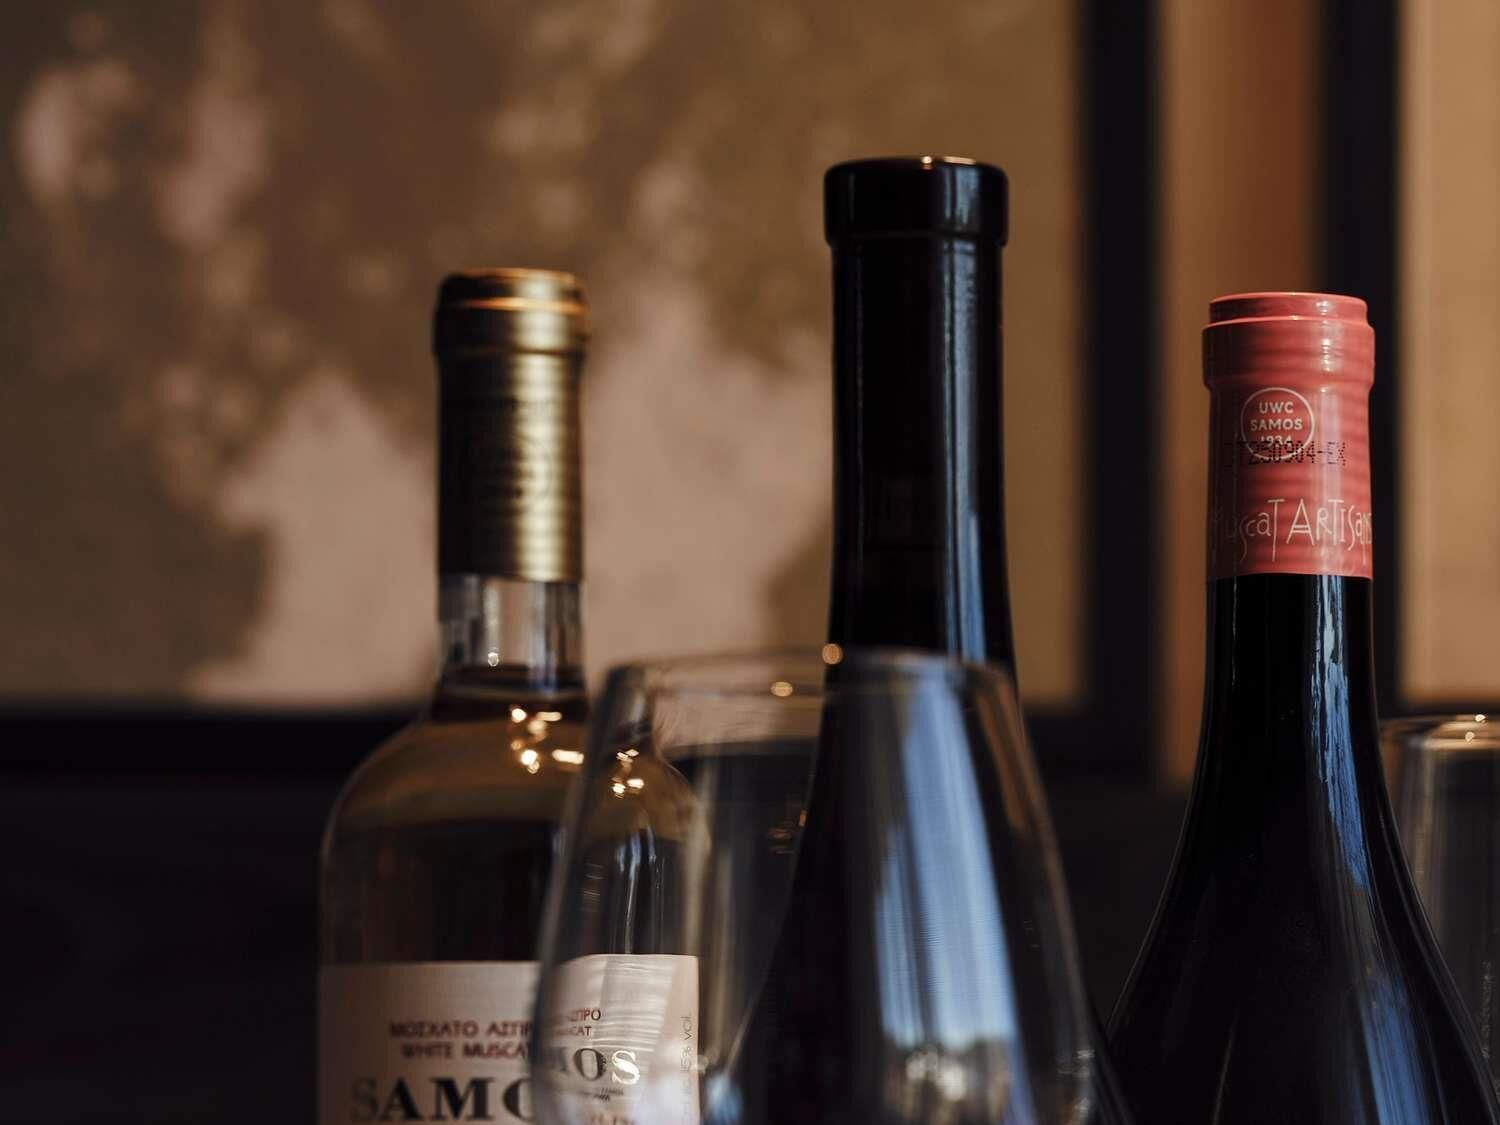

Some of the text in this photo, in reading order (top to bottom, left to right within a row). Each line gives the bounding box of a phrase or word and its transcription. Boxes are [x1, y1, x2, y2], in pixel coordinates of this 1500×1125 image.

[1258, 401, 1294, 414] UWC
[1250, 419, 1303, 431] SAMOS
[402, 1042, 453, 1058] WHITE
[351, 1076, 537, 1122] SAMO
